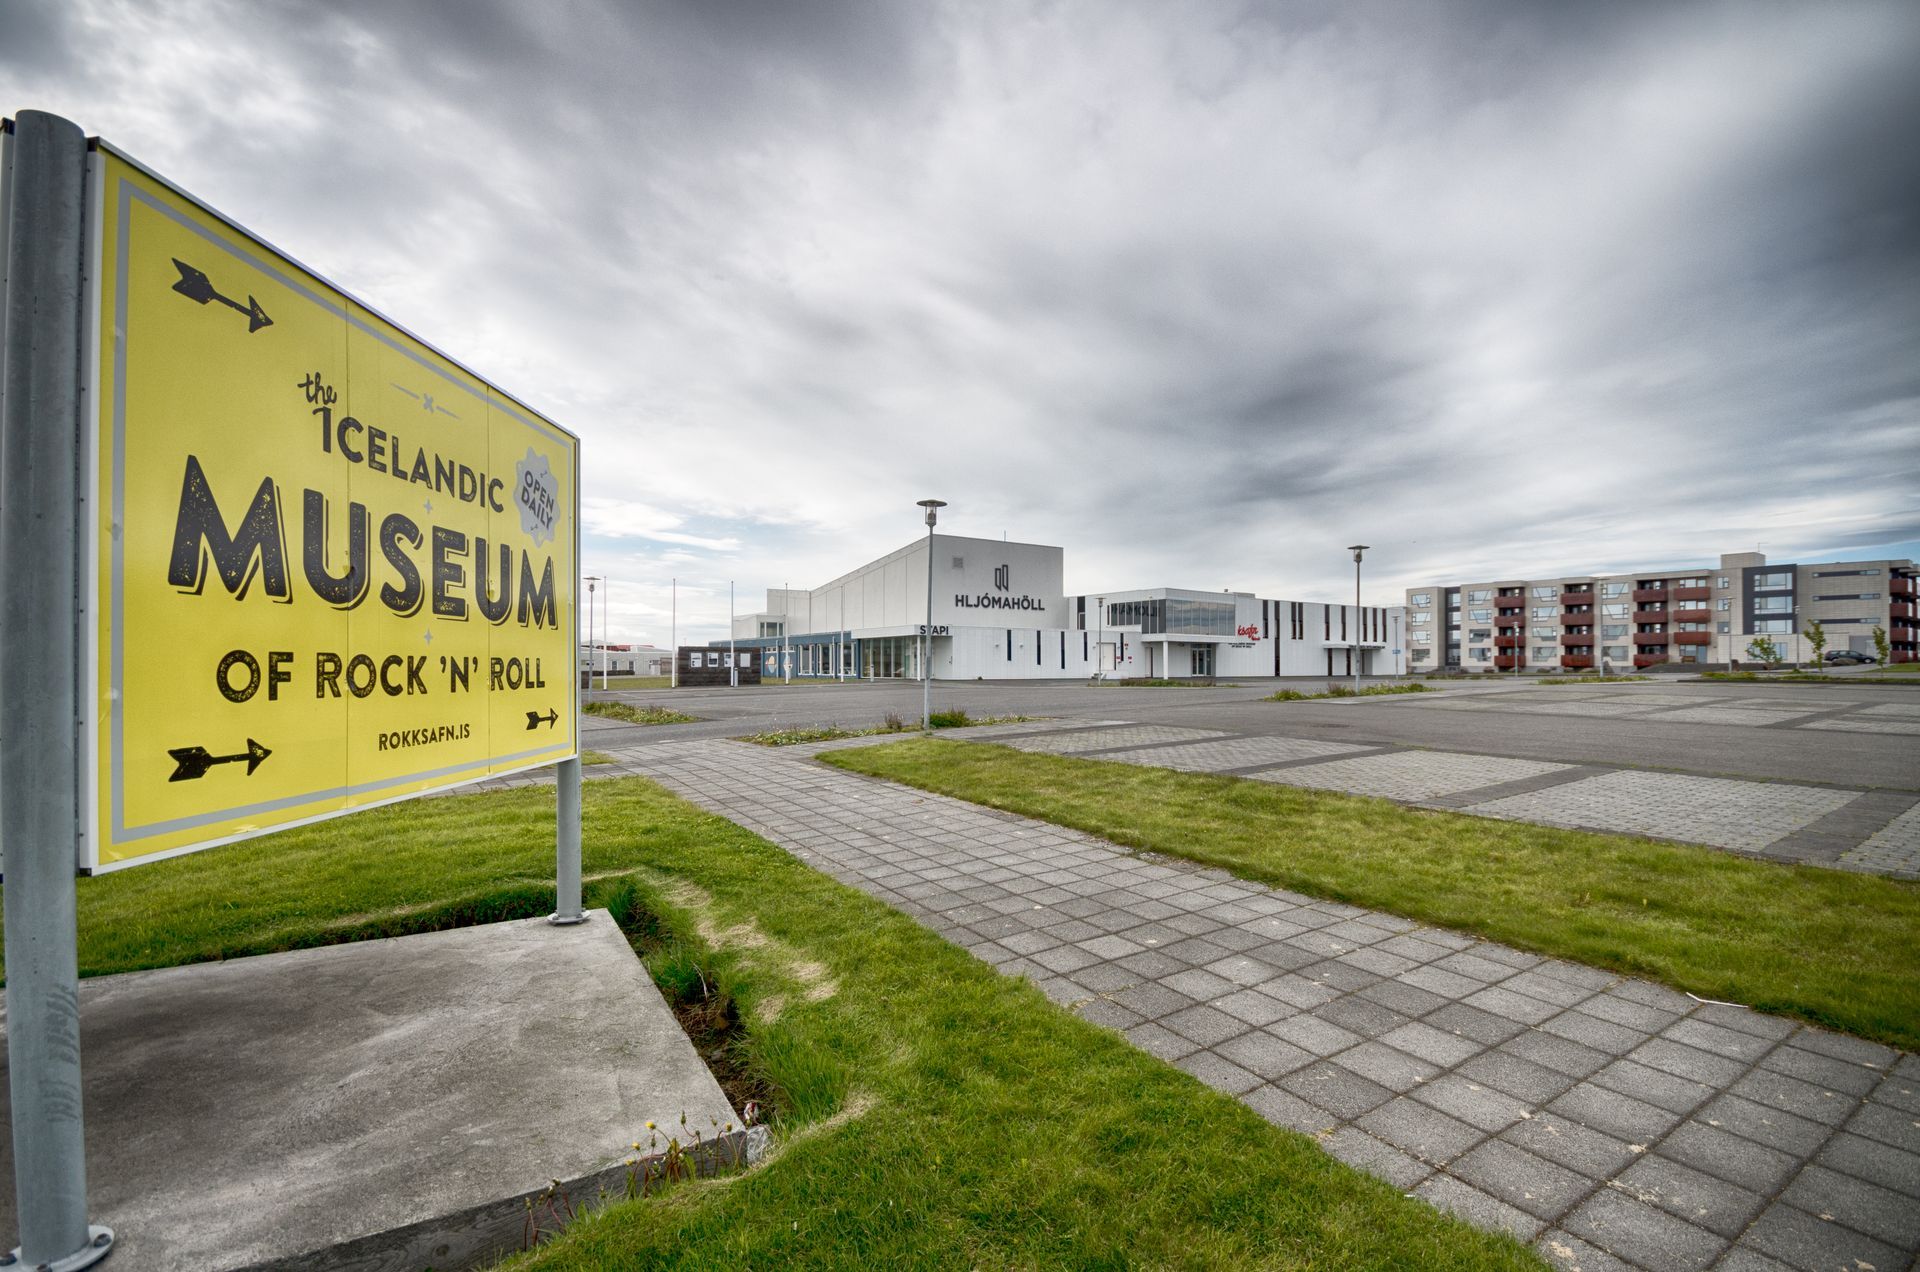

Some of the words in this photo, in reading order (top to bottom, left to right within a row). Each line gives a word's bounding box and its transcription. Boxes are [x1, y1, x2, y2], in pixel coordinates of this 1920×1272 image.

[297, 371, 338, 405] the
[312, 406, 505, 513] ICELANDIC
[521, 485, 553, 530] DAILY
[524, 470, 554, 514] OPEN
[168, 454, 559, 630] MUSEUM
[955, 592, 1046, 611] HLJÓMAHÖLL
[216, 649, 294, 702] OF
[316, 652, 428, 699] ROCK
[489, 657, 546, 691] ROLL
[378, 723, 471, 751] ROKKSAFN.IS
